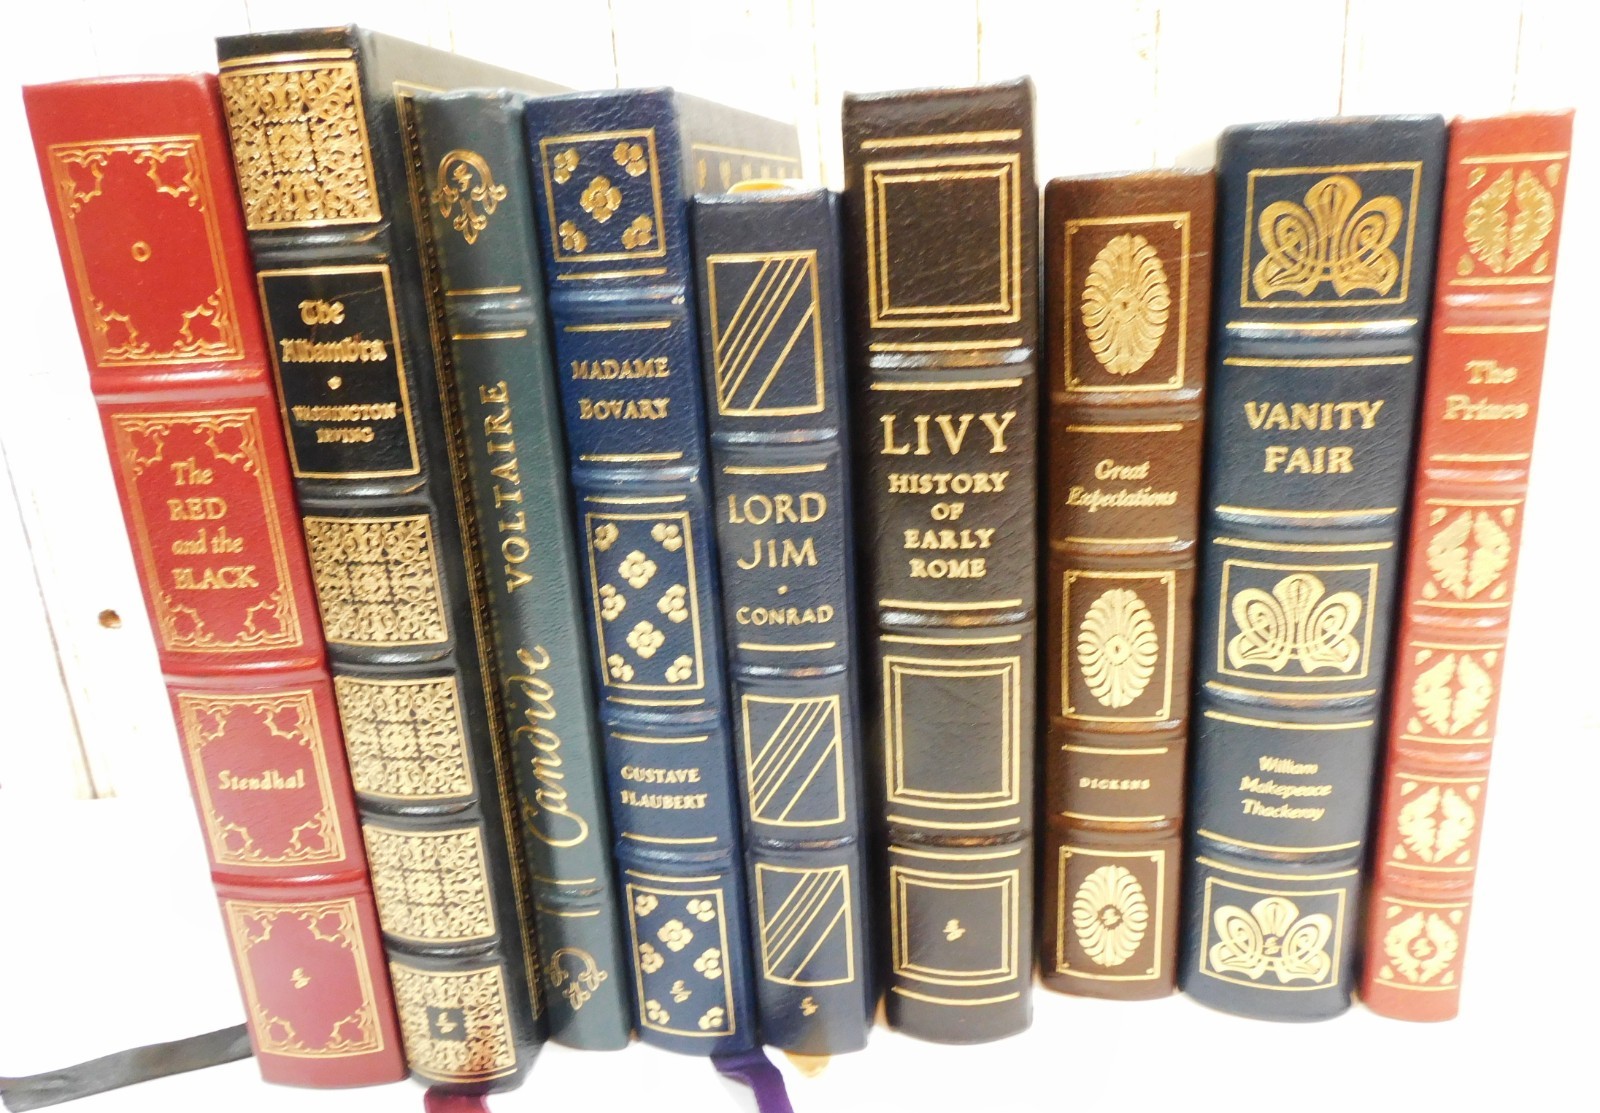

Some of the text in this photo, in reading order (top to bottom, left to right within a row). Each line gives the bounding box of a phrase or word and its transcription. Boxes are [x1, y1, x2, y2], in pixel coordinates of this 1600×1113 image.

[298, 299, 345, 325] The
[279, 336, 388, 363] Alhambra
[570, 356, 671, 380] MADAME
[1464, 360, 1518, 384] The
[577, 397, 671, 420] BOVARY
[1244, 399, 1385, 431] VANITY
[1442, 393, 1529, 420] Prince
[879, 410, 1017, 456] LIVY
[170, 456, 214, 486] The
[1094, 458, 1151, 481] Great
[1263, 445, 1355, 474] FAIR
[478, 379, 534, 594] VOLTAIRE
[887, 470, 1010, 495] HISTORY
[166, 497, 228, 521] RED
[727, 491, 828, 525] LORD
[930, 502, 965, 521] OF
[1065, 485, 1179, 513] Expectations
[171, 525, 244, 555] and the
[903, 527, 996, 550] EARLY
[736, 536, 818, 570] JIM
[171, 564, 259, 590] BLACK
[908, 557, 987, 579] ROME
[735, 603, 835, 626] CONRAD
[505, 644, 589, 847] Candide
[620, 765, 701, 784] GUSTAVE
[1258, 755, 1319, 775] William
[218, 768, 305, 791] Stendhal
[1079, 776, 1151, 791] DICKENS
[1239, 775, 1333, 800] Makepeace
[620, 789, 708, 810] FLAUBERT
[1240, 798, 1326, 822] Thackeray
